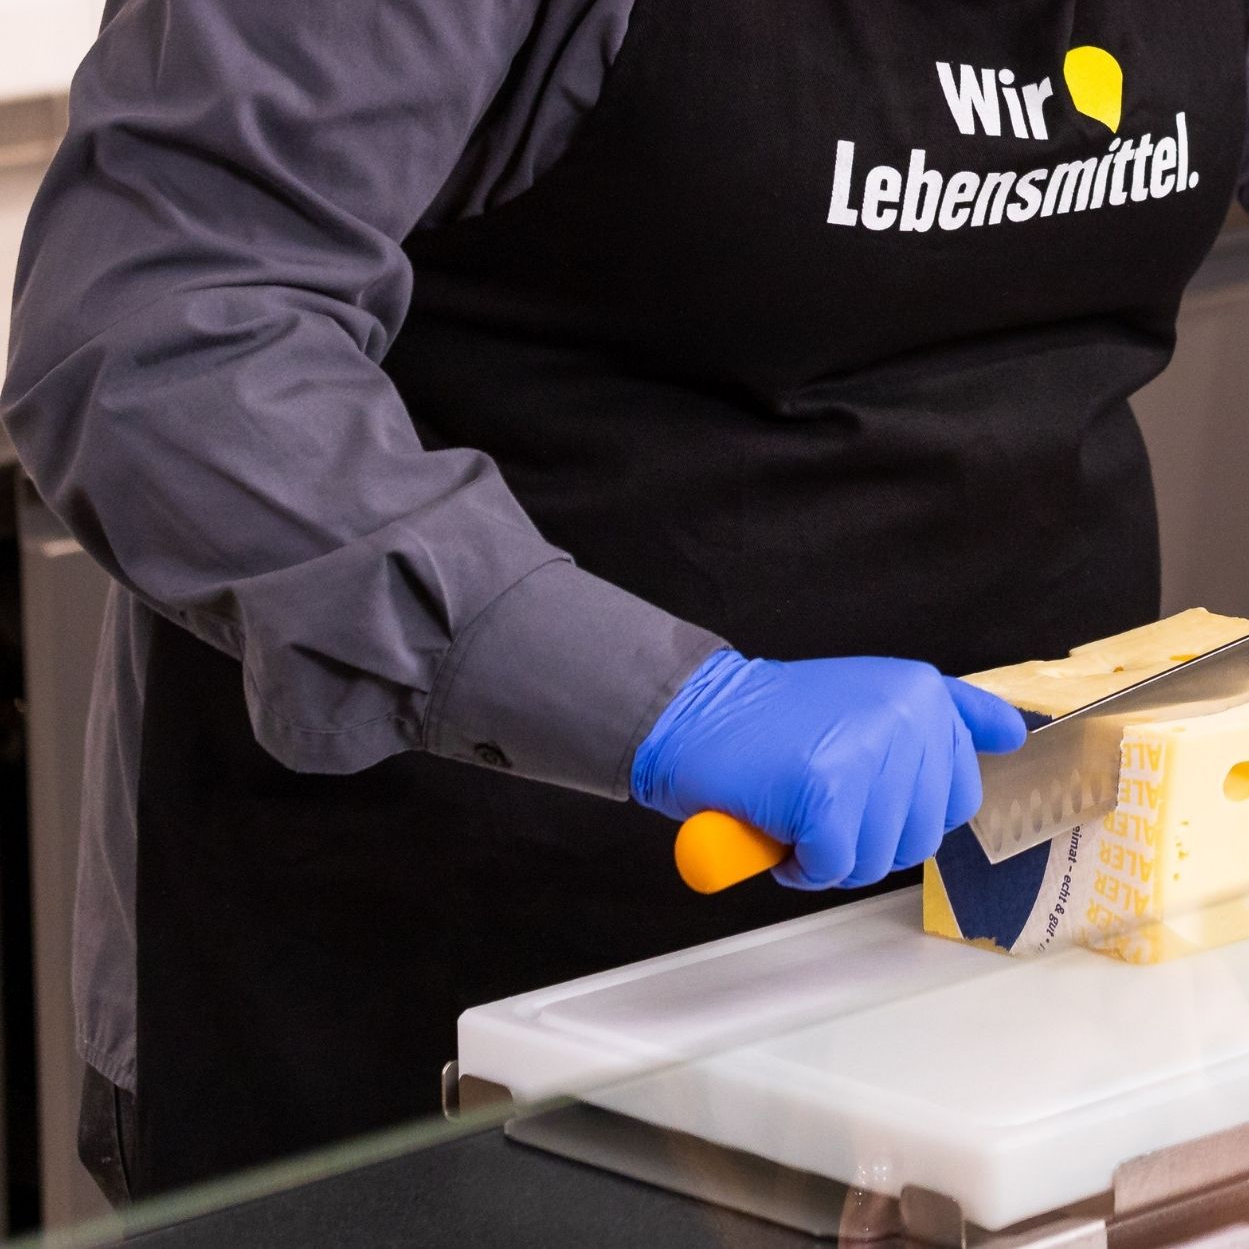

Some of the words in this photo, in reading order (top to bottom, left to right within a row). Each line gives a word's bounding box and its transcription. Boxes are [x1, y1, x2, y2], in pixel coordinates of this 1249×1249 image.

[935, 61, 1053, 140] Wir
[827, 112, 1199, 232] Lebensmittel.
[1068, 824, 1083, 863] eimat
[1059, 874, 1071, 903] echt
[1094, 869, 1150, 918] ALER
[1046, 913, 1059, 938] gut
[1054, 903, 1065, 915] &
